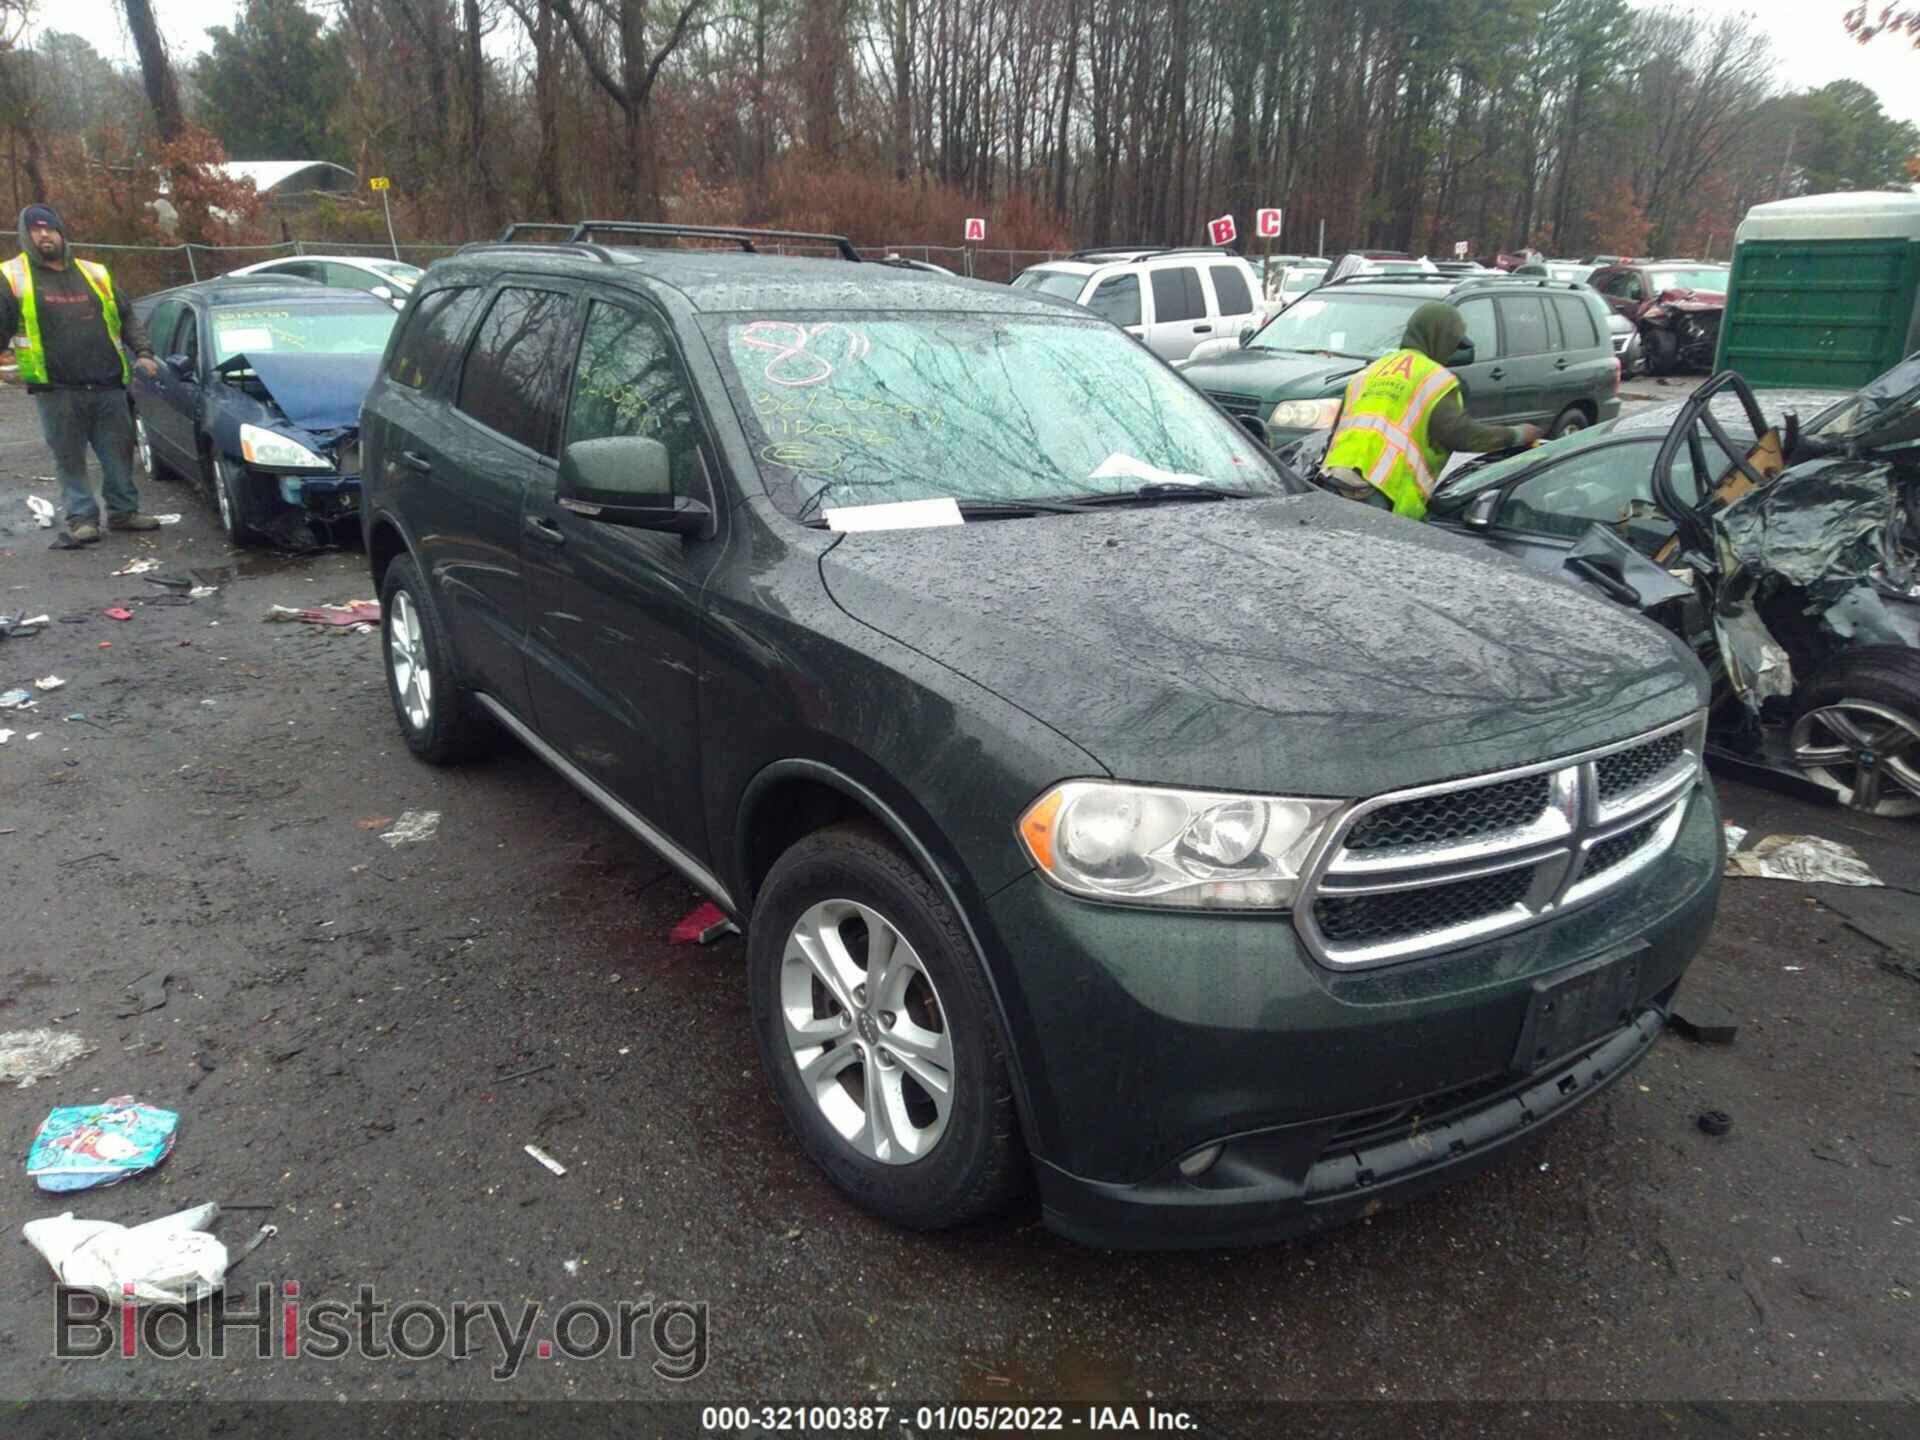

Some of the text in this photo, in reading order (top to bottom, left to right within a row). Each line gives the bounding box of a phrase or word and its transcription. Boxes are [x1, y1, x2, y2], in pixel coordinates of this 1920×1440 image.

[968, 220, 983, 238] A
[1213, 219, 1234, 243] B
[1261, 211, 1279, 235] C
